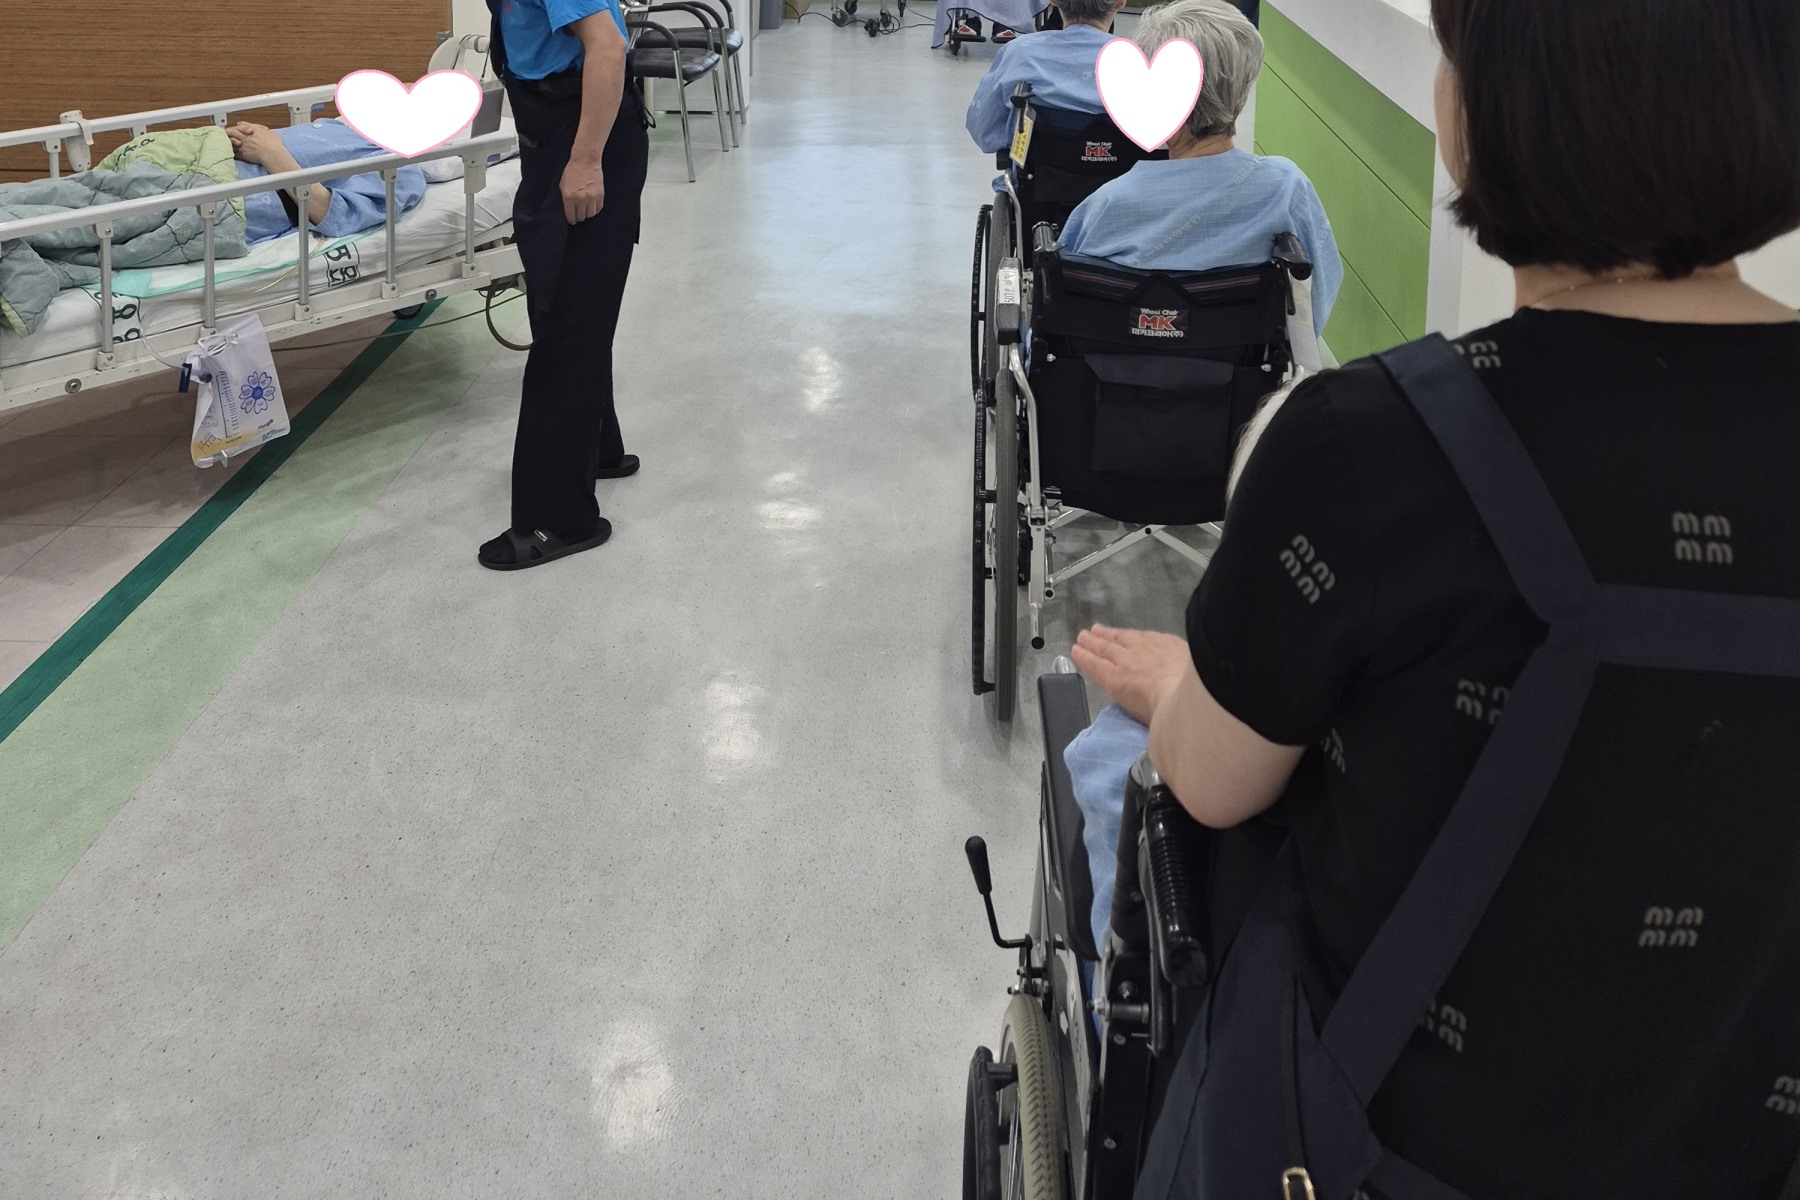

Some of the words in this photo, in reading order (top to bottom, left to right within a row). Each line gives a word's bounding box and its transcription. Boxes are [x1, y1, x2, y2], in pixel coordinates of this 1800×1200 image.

[1085, 145, 1112, 157] MK
[1141, 307, 1160, 315] Wheel
[1138, 314, 1178, 331] MK
